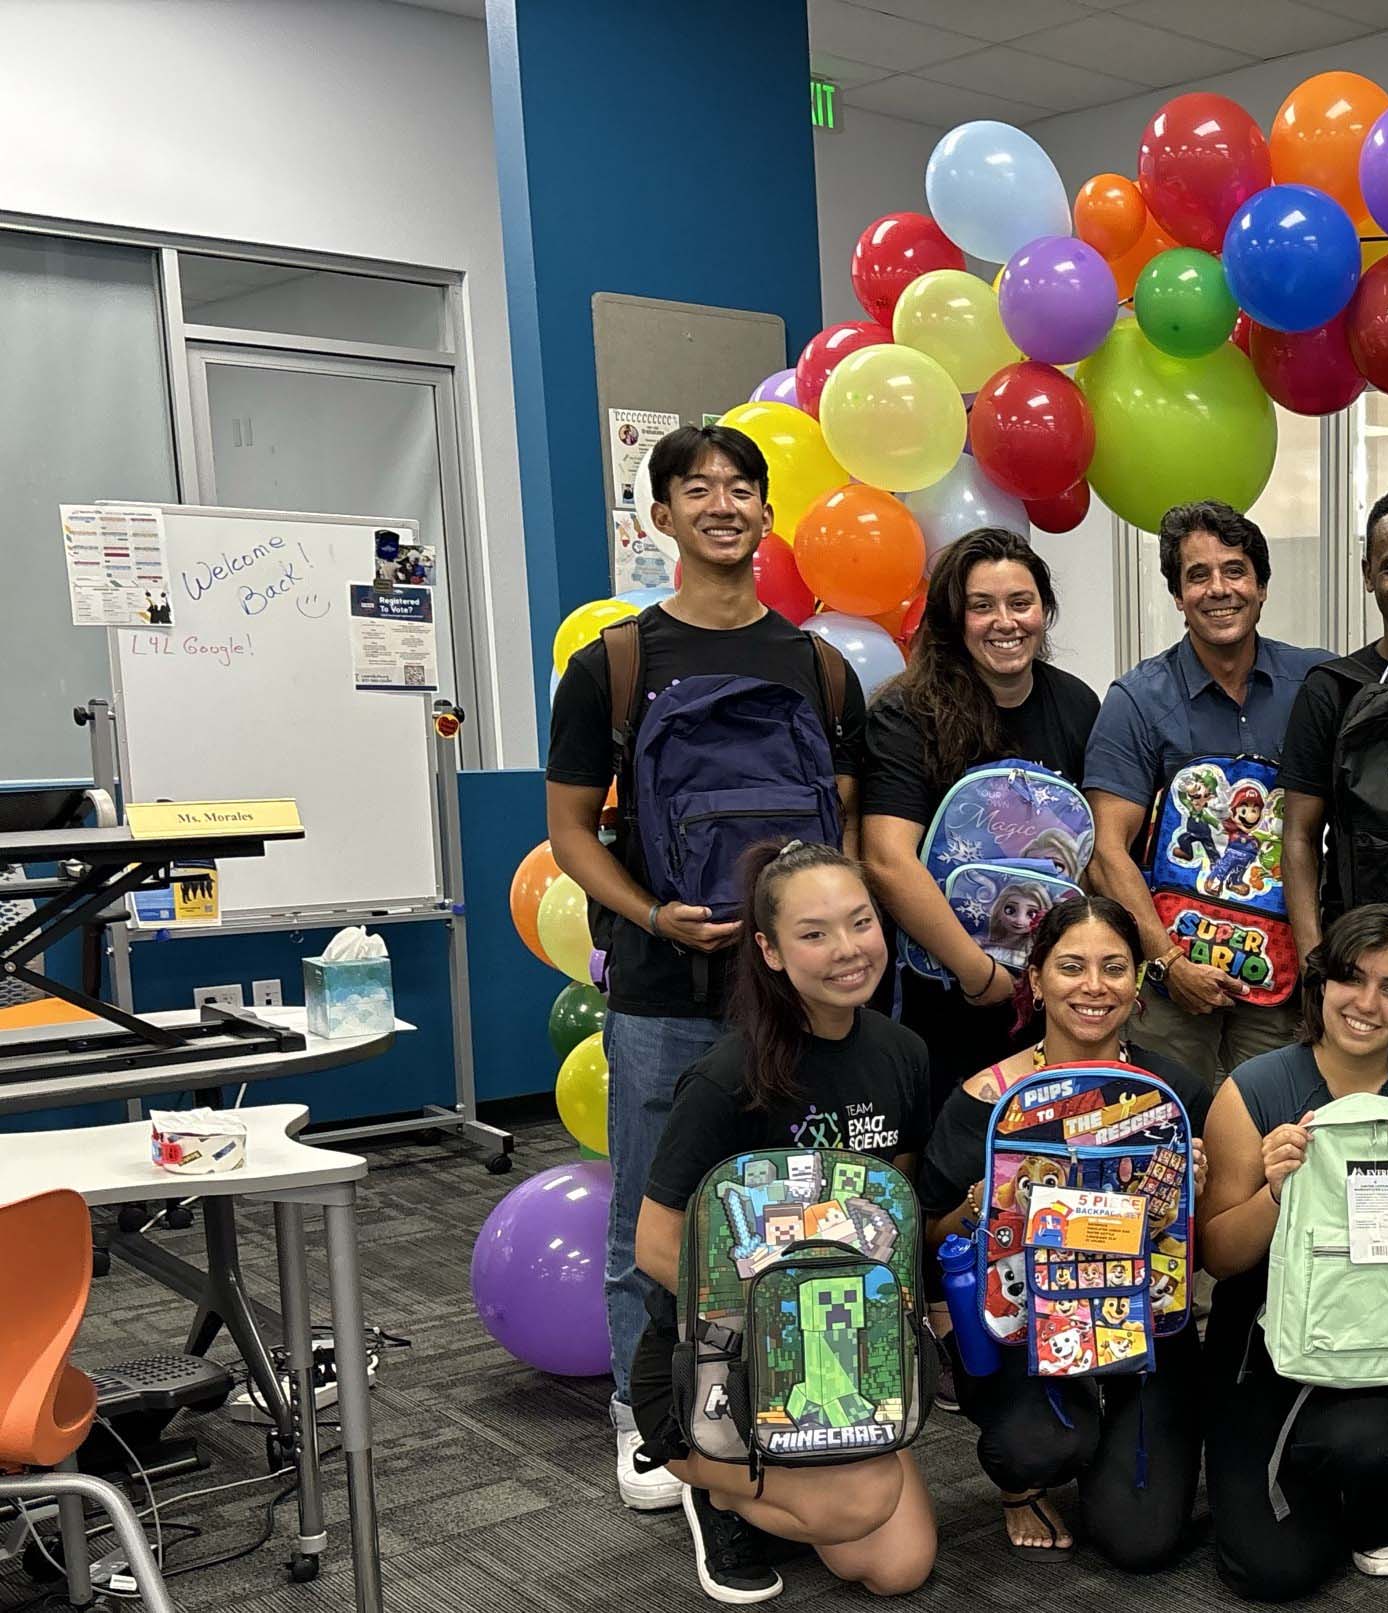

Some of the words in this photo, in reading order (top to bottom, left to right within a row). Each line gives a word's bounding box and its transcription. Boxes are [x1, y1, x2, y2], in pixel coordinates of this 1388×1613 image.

[810, 82, 835, 128] IT
[182, 536, 286, 600] Welcome
[379, 596, 421, 607] Registered
[379, 605, 389, 613] To
[390, 605, 413, 614] Vote?
[183, 633, 255, 667] Google!
[177, 813, 201, 823] Ms.
[203, 811, 254, 823] Morales
[947, 802, 1037, 845] Magic
[1176, 912, 1265, 953] SUPER
[1024, 1079, 1074, 1107] PUPS
[845, 1102, 874, 1117] TEAM
[1036, 1108, 1055, 1123] TO
[1065, 1109, 1103, 1136] THE
[848, 1115, 886, 1137] EXACT
[1095, 1101, 1173, 1146] RESCUE!
[848, 1129, 899, 1152] SCIENCES
[1078, 1194, 1089, 1206] 5
[1092, 1195, 1141, 1211] PIE
[769, 1424, 896, 1454] MINECRAFT
